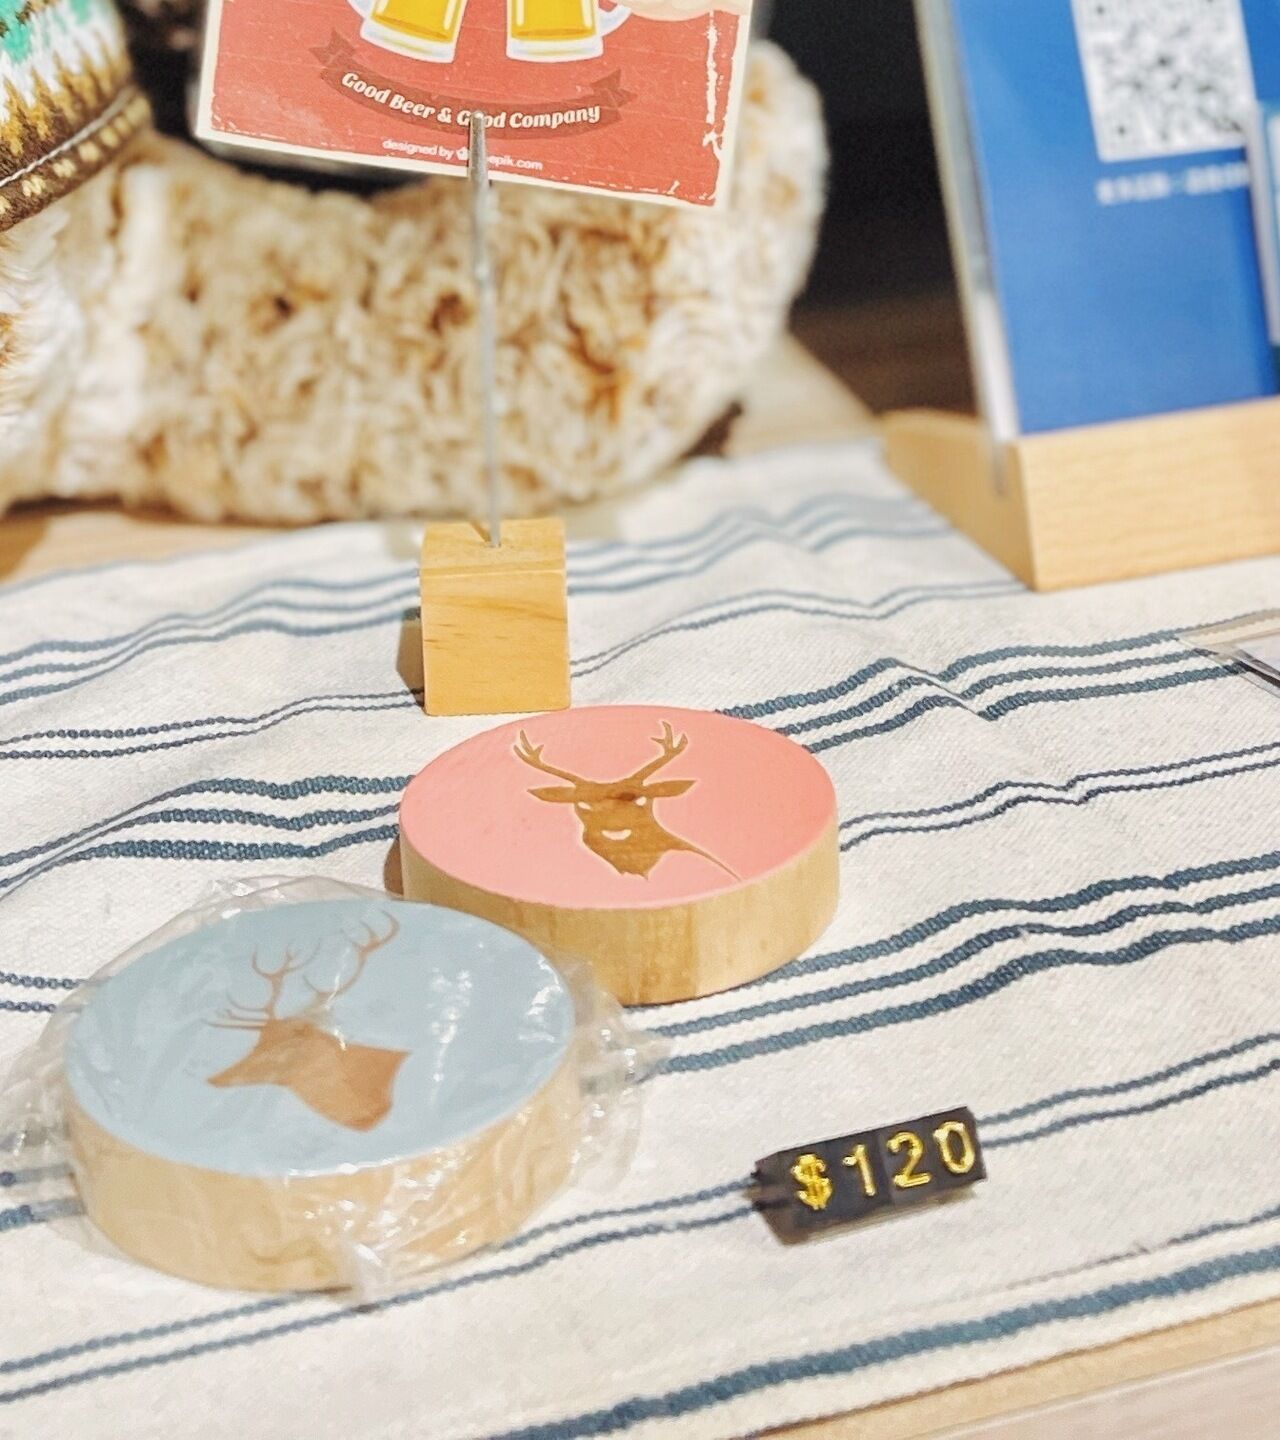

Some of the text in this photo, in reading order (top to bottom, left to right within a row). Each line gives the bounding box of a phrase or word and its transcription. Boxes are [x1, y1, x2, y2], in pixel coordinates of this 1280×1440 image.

[341, 71, 601, 129] Good Beer & God Company
[382, 138, 438, 157] designed
[438, 145, 454, 160] by
[790, 1120, 976, 1211] $120
